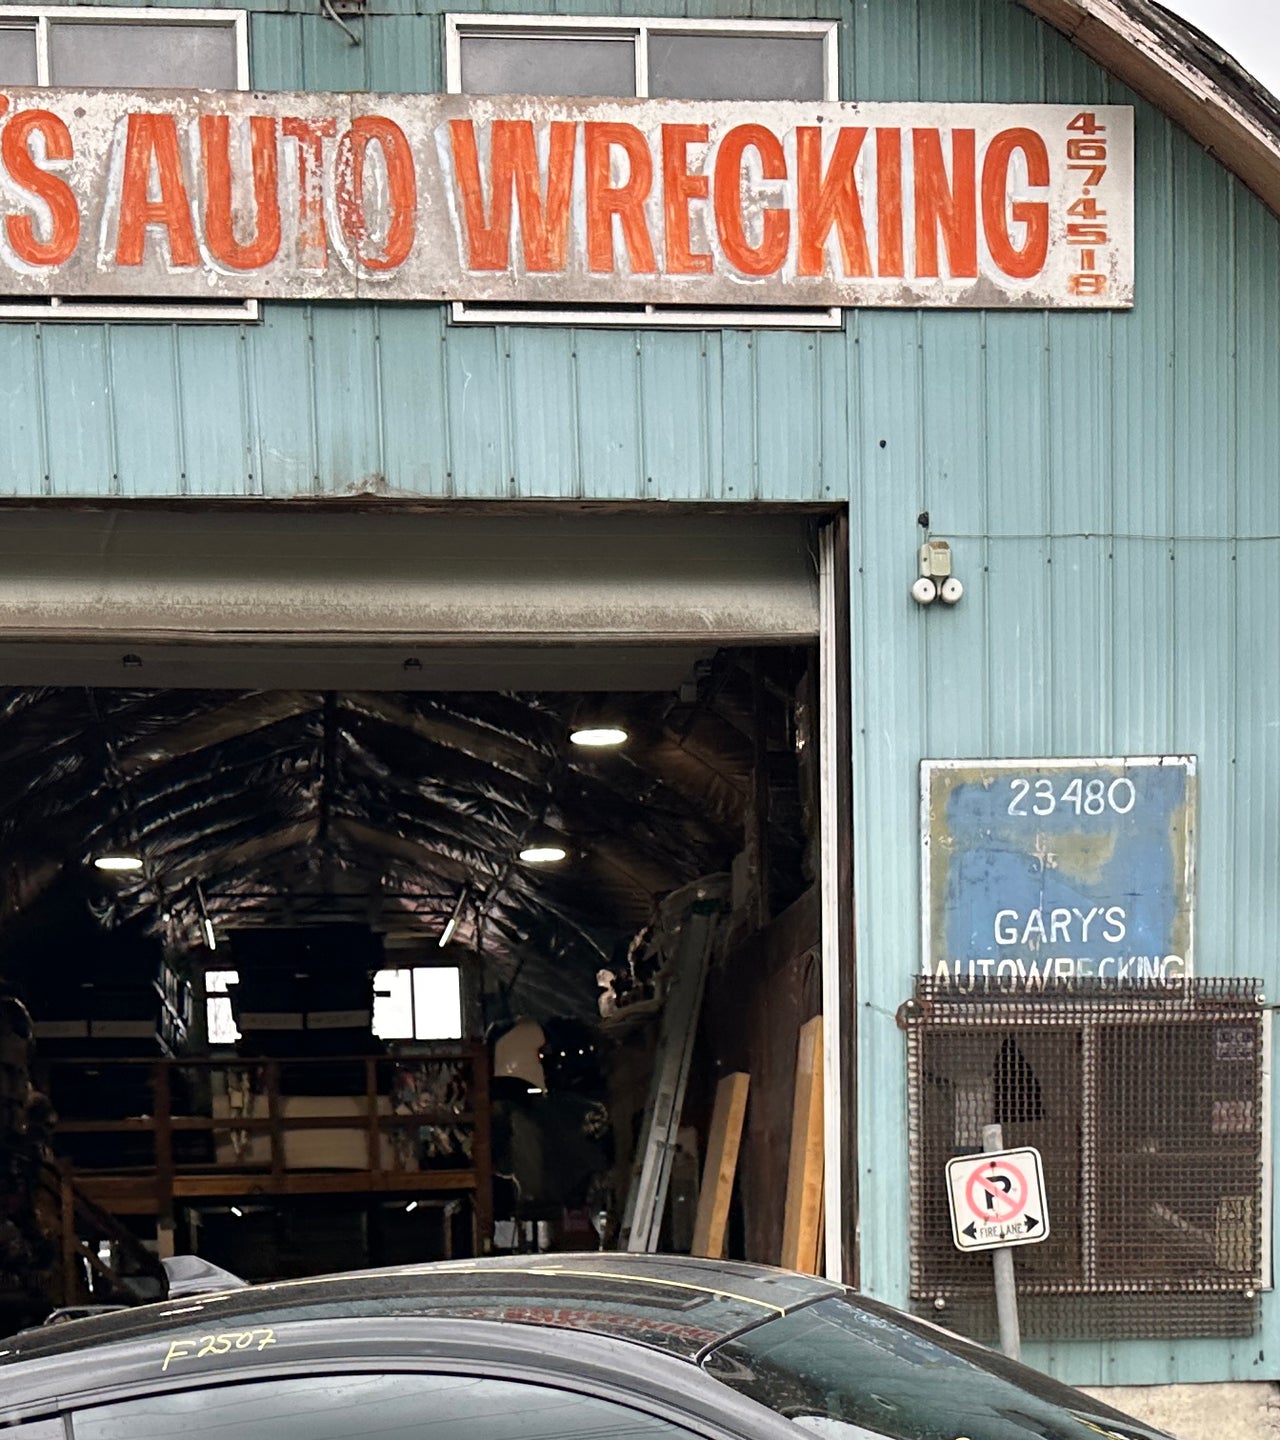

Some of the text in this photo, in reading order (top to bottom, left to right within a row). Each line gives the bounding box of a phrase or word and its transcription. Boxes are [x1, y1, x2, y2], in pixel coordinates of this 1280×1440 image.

[116, 113, 417, 271] AUTO
[448, 118, 1051, 279] WRECKING
[1007, 777, 1137, 816] 23480
[993, 906, 1127, 945] GARY'S
[980, 1222, 1023, 1238] FIRE LANE
[162, 1328, 276, 1371] F2507
